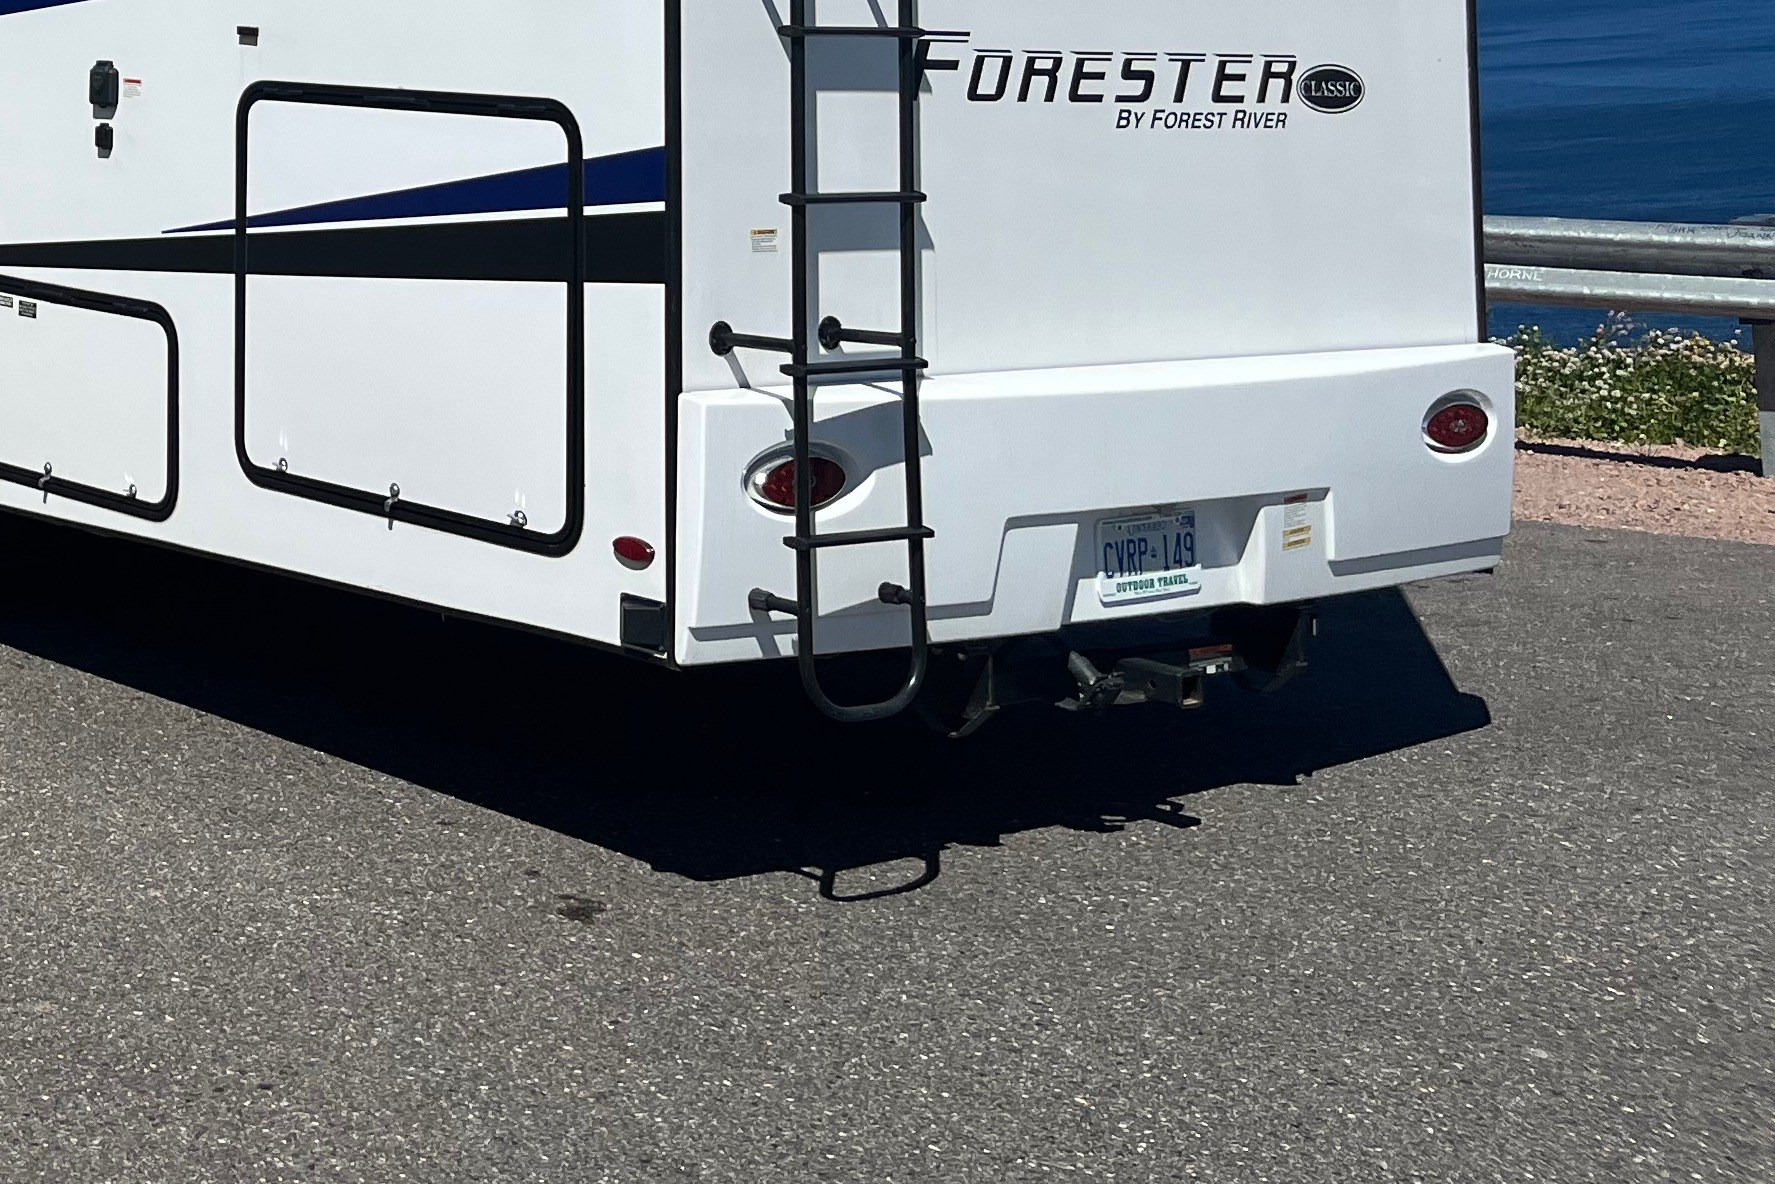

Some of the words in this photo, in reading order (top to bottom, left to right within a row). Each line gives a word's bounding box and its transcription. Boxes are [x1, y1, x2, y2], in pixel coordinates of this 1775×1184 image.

[913, 31, 1297, 104] FORESTER
[1300, 78, 1362, 98] CLASSIC
[1116, 109, 1144, 129] BY
[1150, 109, 1228, 129] FOREST
[1231, 109, 1288, 129] RIVER
[1116, 578, 1155, 594] OUTDOOR
[1157, 573, 1189, 588] TRAVEL
